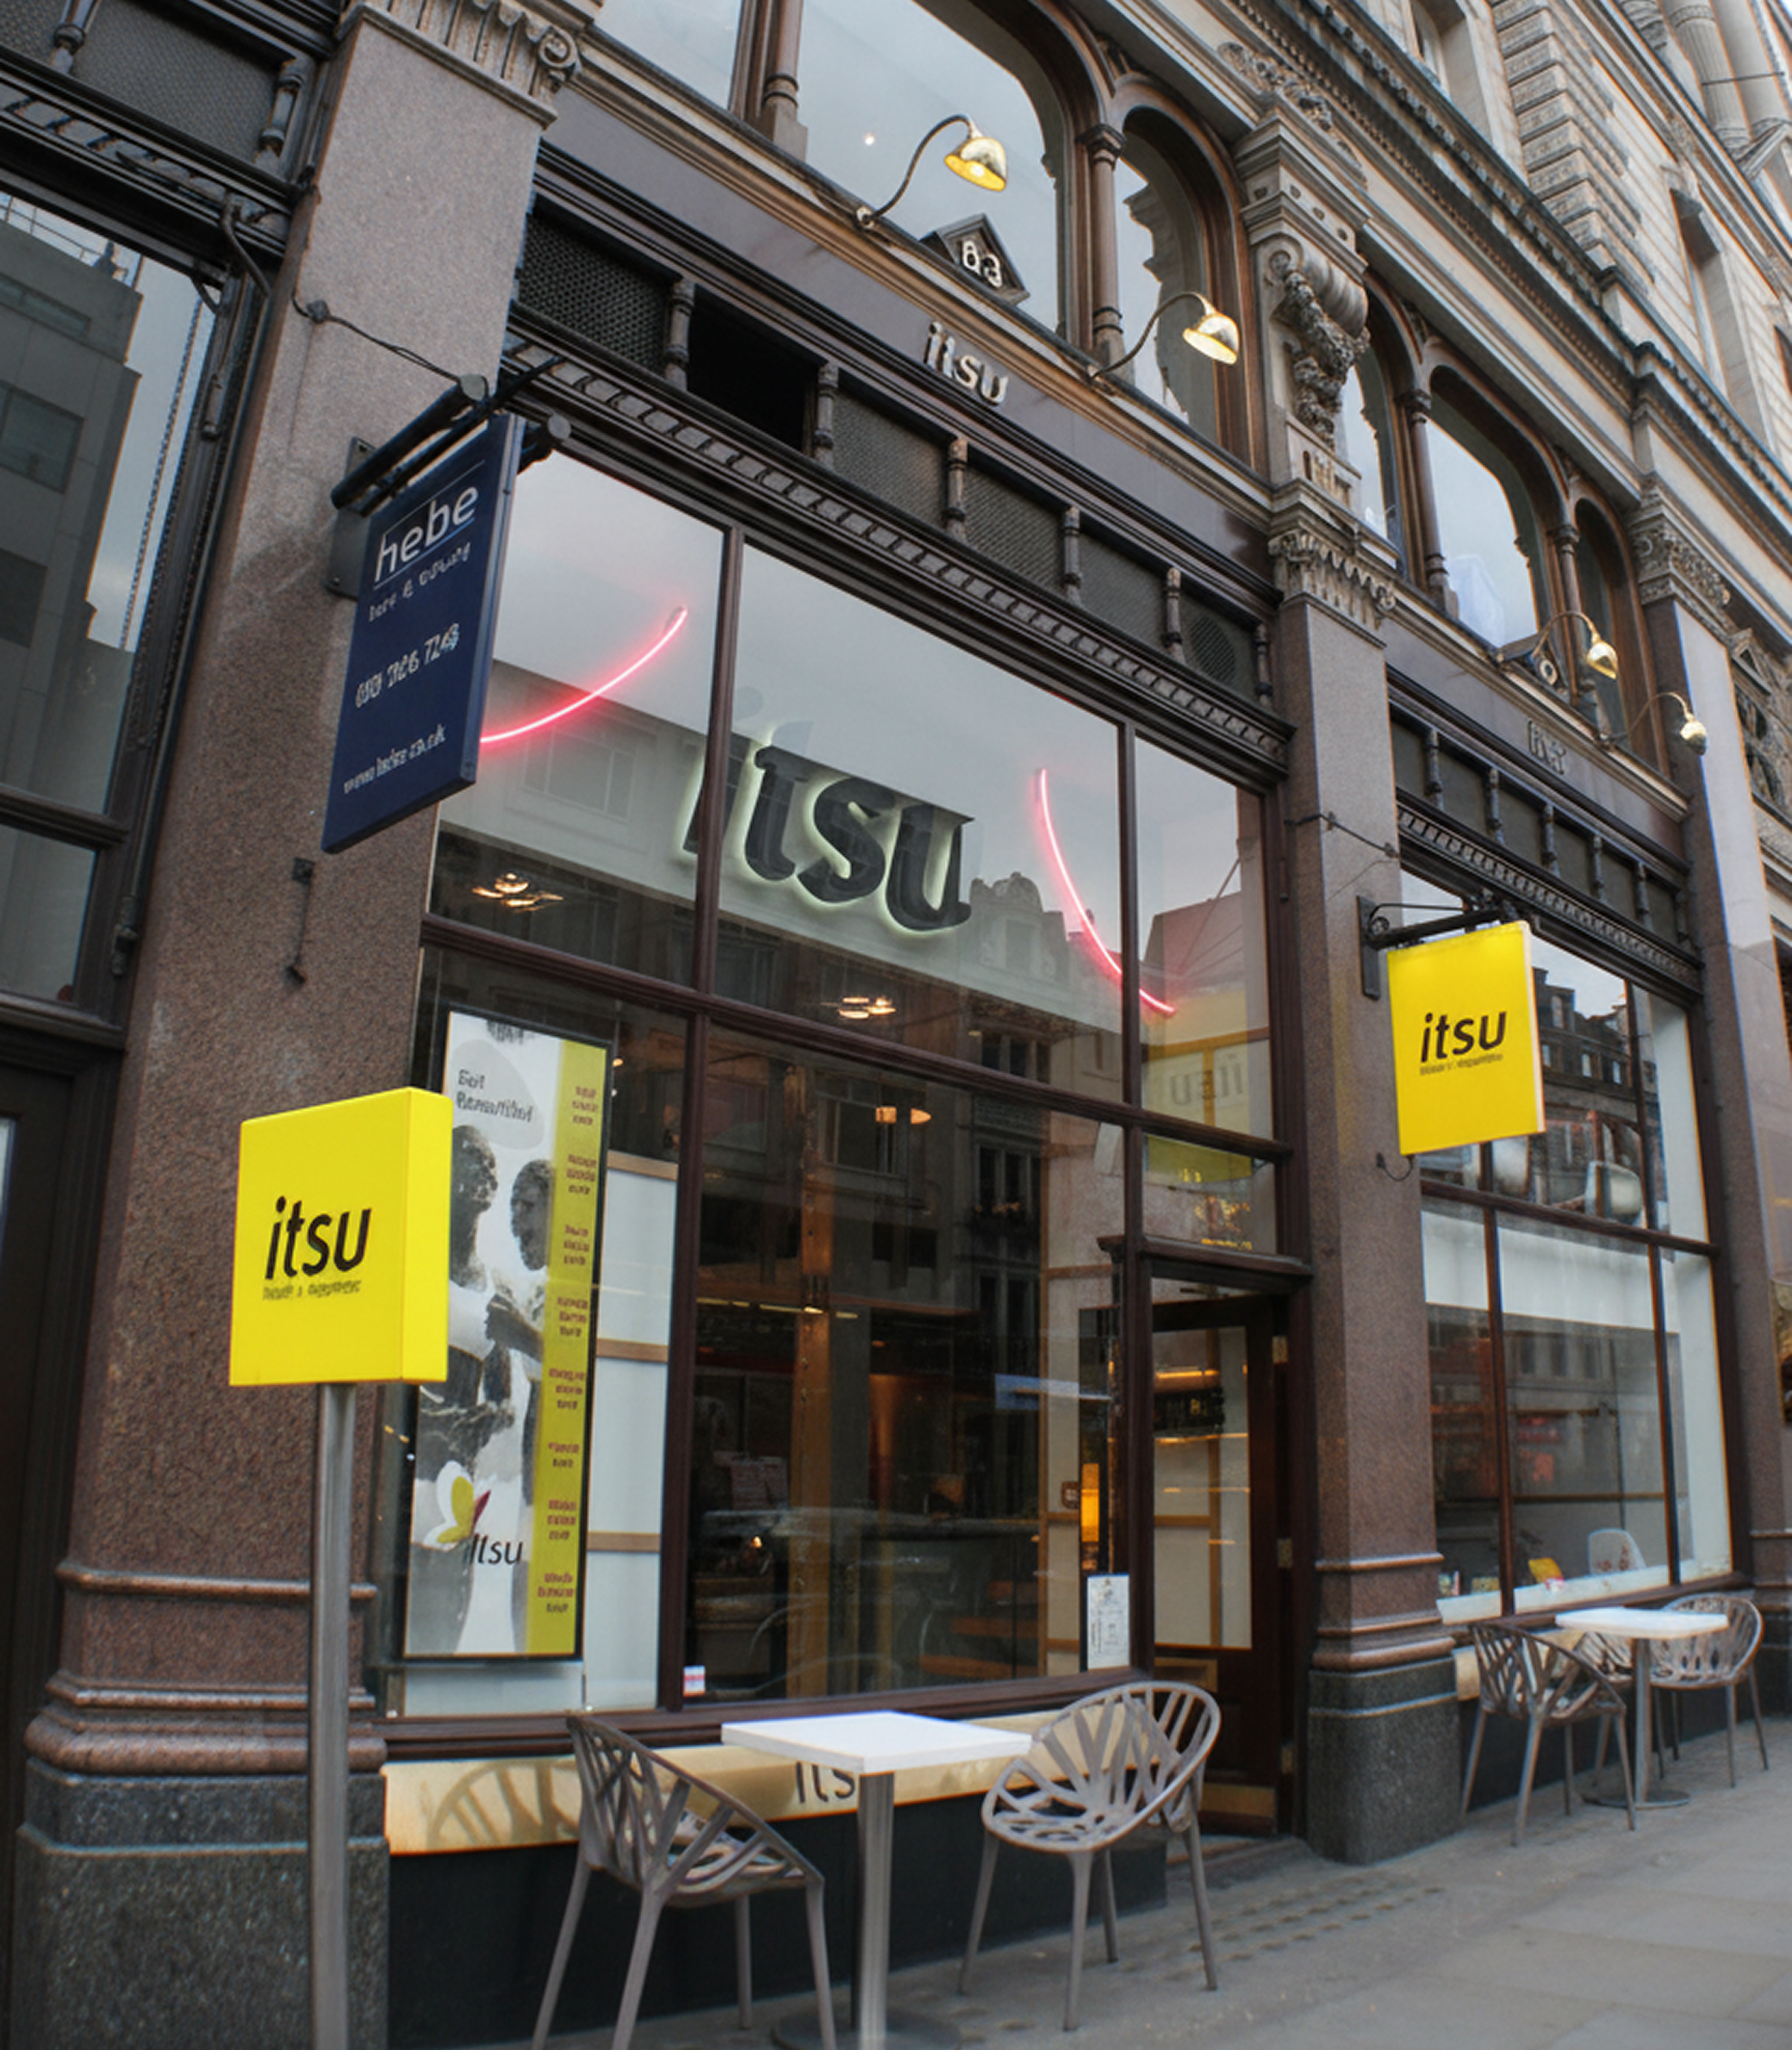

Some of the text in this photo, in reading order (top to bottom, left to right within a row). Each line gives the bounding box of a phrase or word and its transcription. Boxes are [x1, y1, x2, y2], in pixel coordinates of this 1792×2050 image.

[961, 240, 1003, 289] 83
[924, 321, 1009, 405] itsu
[373, 486, 478, 583] hebe
[682, 686, 974, 932] itsu
[1421, 1011, 1507, 1062] itsu
[265, 1196, 373, 1280] itsu
[795, 1761, 856, 1803] its
